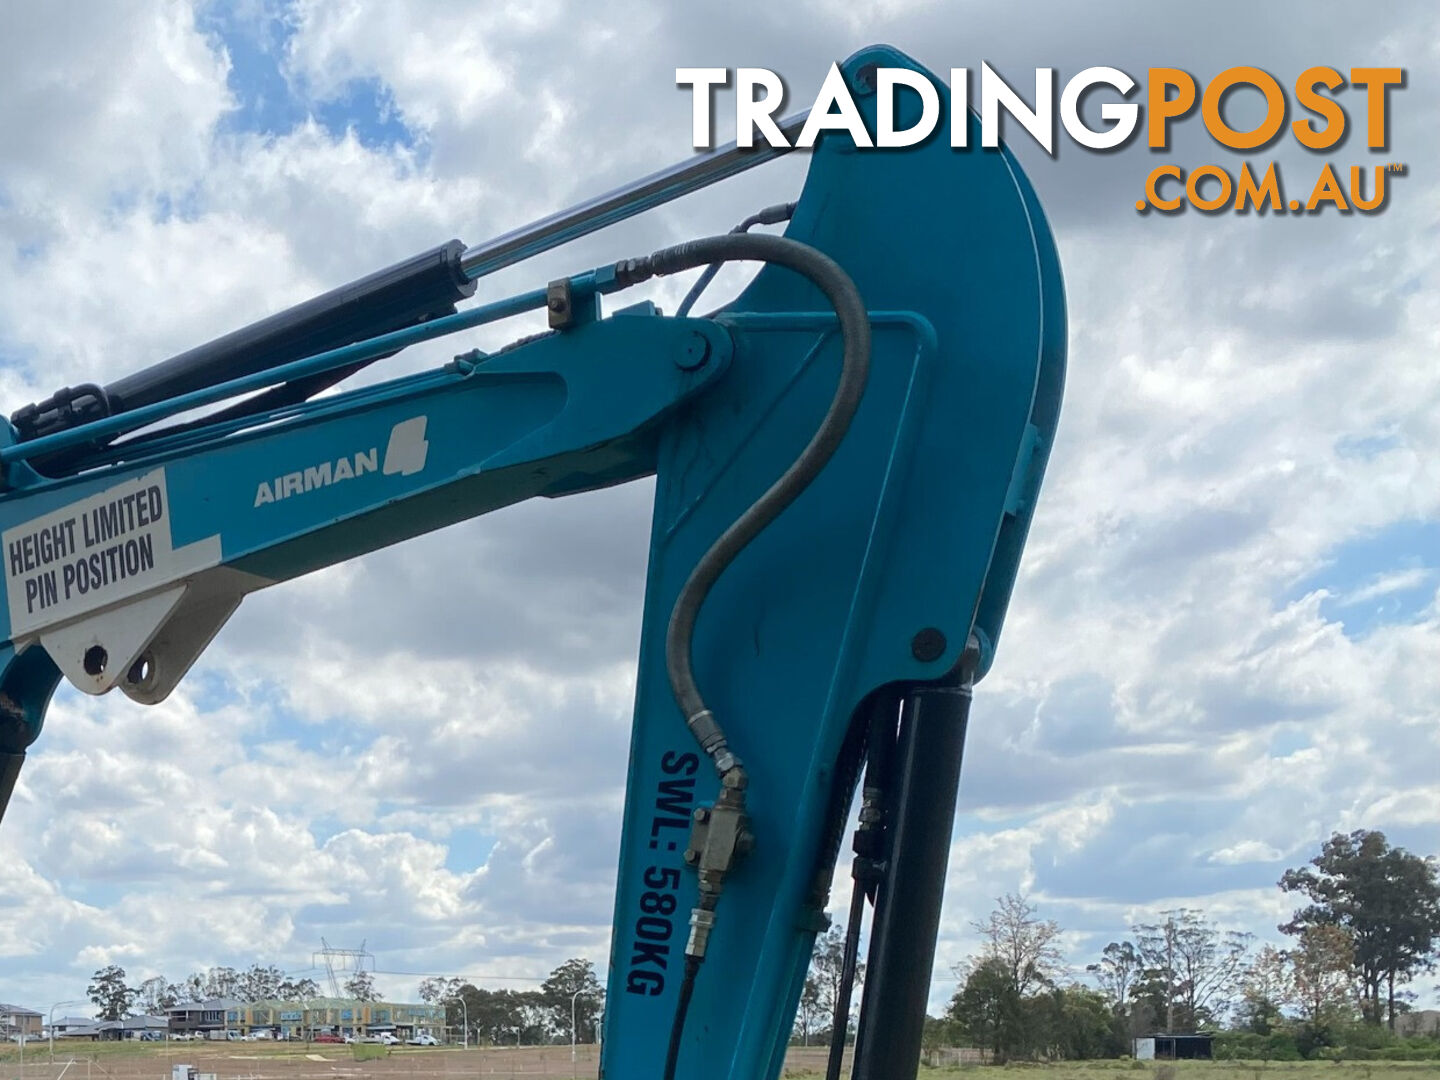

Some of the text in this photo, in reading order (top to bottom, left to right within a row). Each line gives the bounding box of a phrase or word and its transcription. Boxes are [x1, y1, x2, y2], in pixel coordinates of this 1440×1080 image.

[254, 447, 378, 508] AIRMAN
[9, 485, 163, 577] HEIGHT LIMITED
[25, 533, 154, 614] PIN POSITION
[626, 750, 700, 997] SWL: 580KG
